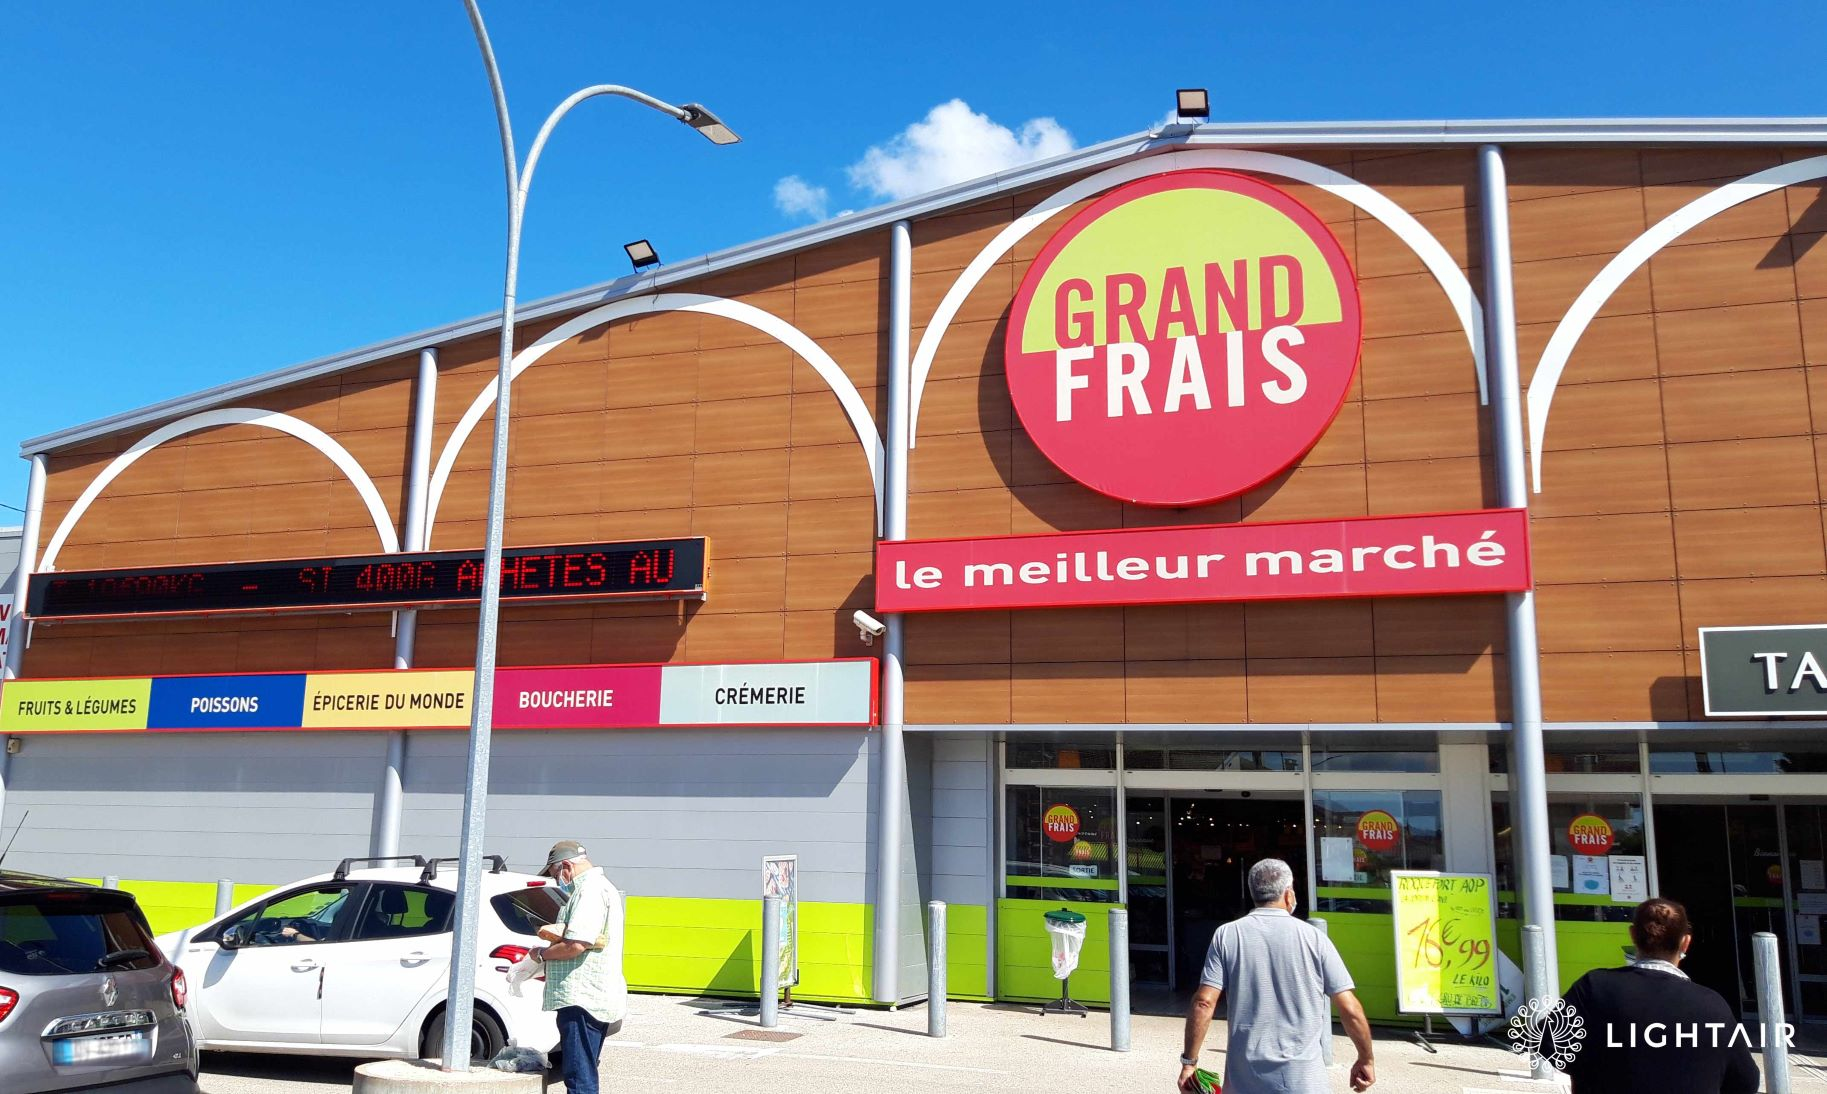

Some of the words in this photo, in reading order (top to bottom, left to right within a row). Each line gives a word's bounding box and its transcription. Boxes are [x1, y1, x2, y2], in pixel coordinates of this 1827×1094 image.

[1054, 254, 1304, 350] GRAND
[1055, 325, 1307, 422] FRAIS
[629, 549, 675, 585] AU
[895, 559, 942, 590] le
[964, 551, 1226, 588] meilleur
[1245, 529, 1507, 578] marché
[1753, 651, 1827, 690] TA
[313, 691, 380, 711] ÉPICERIE
[385, 693, 406, 710] DU
[410, 692, 465, 709] MONDE
[519, 690, 614, 709] BOUCHERIE
[715, 682, 806, 705] CRÉMERIE
[18, 700, 62, 716] FRUITS
[64, 700, 73, 715] &
[76, 695, 136, 715] LÉGUMES
[190, 696, 259, 713] POISSONS
[1048, 815, 1075, 824] GRAND
[1048, 823, 1074, 832] FRAIS
[1362, 821, 1393, 831] GRAND
[1362, 829, 1394, 841] FRAIS
[1573, 825, 1607, 836] GRAND
[1574, 834, 1608, 846] FRAIS
[1460, 878, 1485, 893] AOP
[1453, 974, 1467, 985] LE
